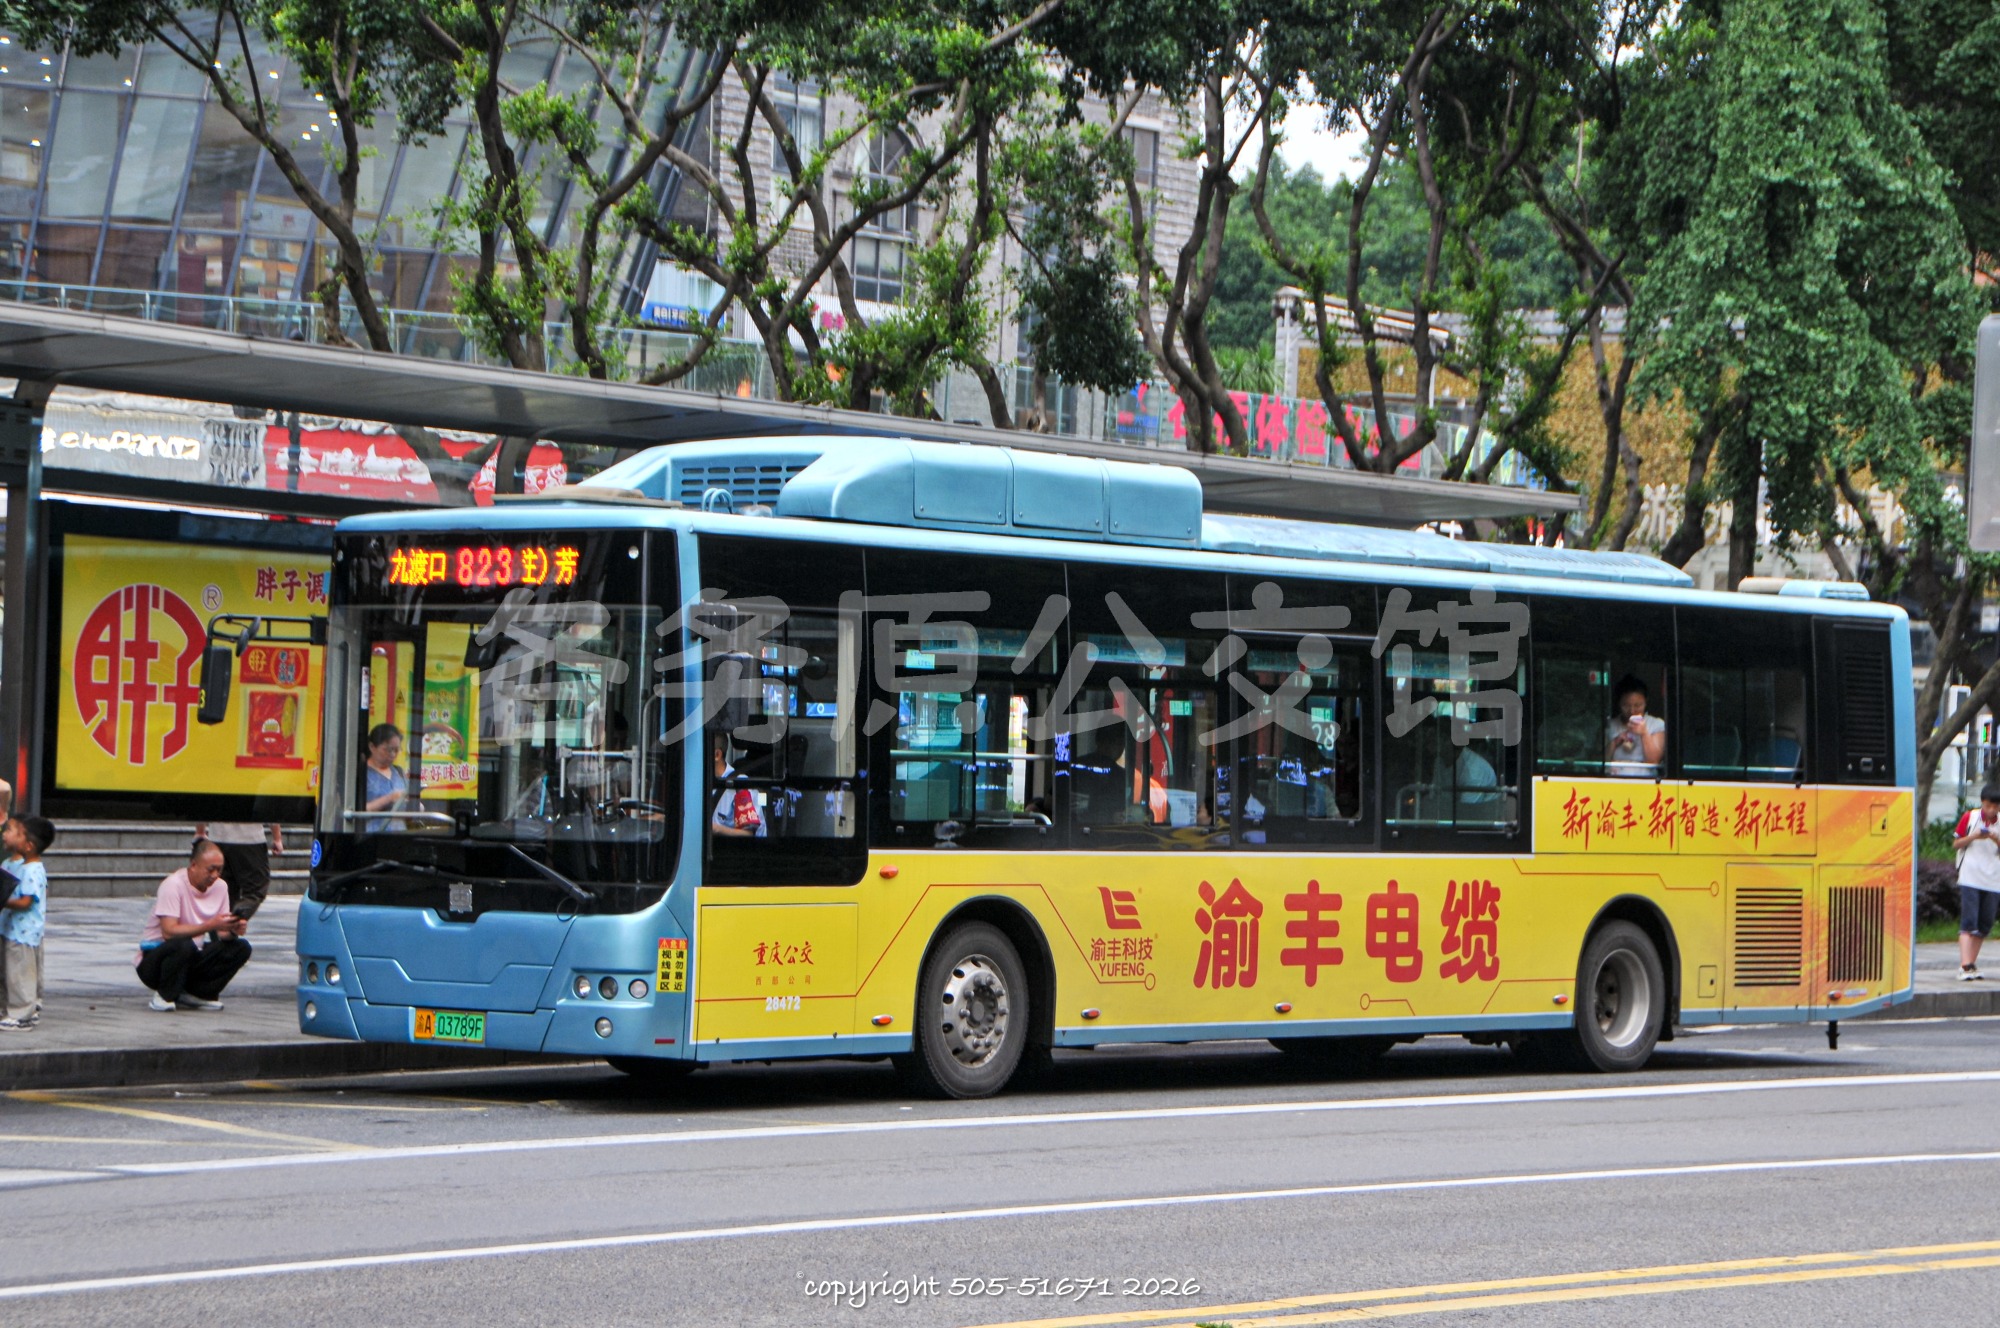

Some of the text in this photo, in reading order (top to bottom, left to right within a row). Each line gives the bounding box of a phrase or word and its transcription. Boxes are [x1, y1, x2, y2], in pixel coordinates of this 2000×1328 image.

[390, 548, 446, 585] 九渡口
[457, 547, 512, 586] 823
[1193, 877, 1501, 989] 渝丰电缆
[753, 940, 814, 966] 重庆公交
[1090, 937, 1153, 961] 渝丰科技
[1099, 962, 1145, 977] YUFENG
[765, 995, 801, 1012] 28472
